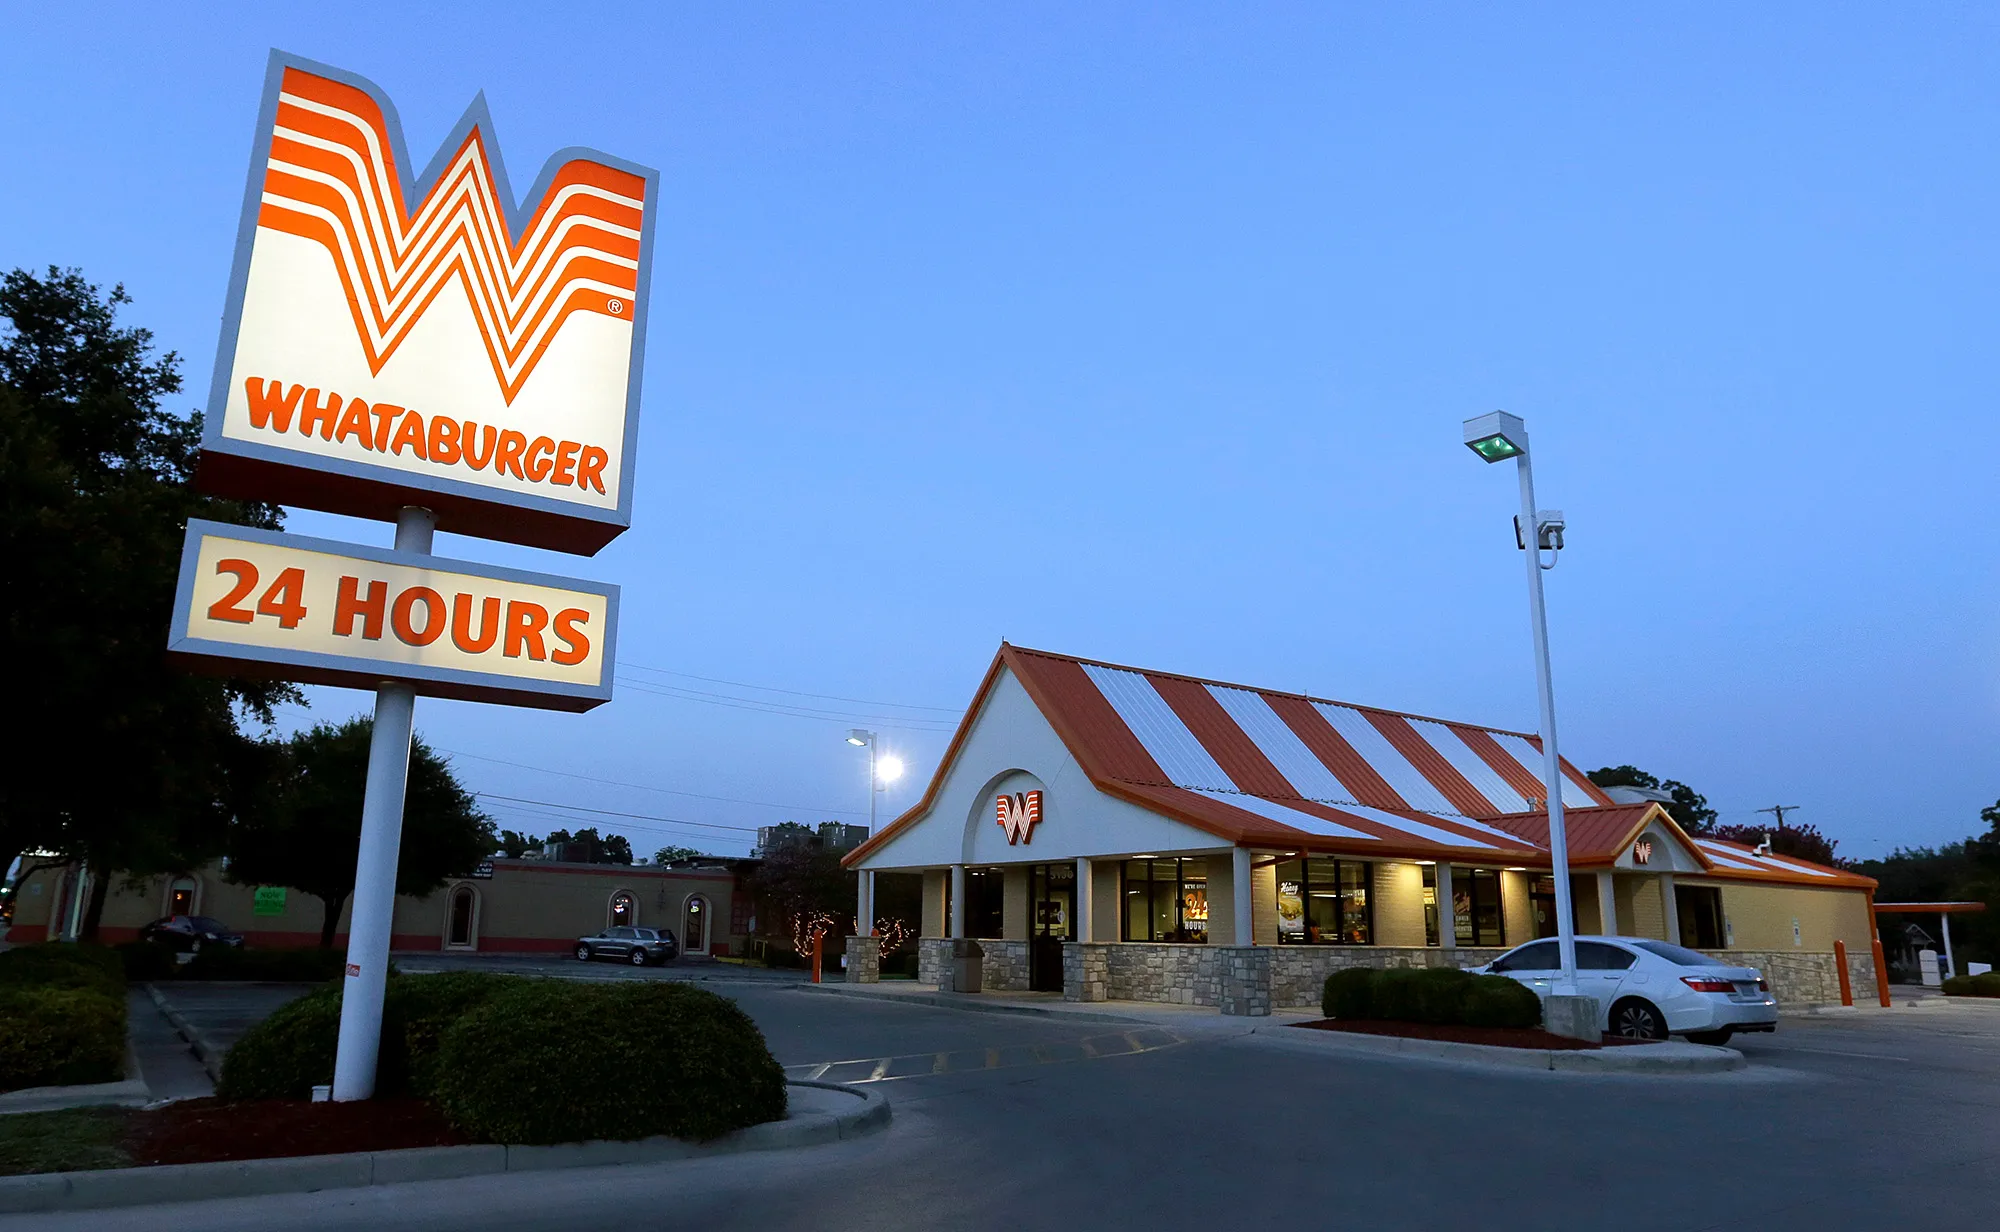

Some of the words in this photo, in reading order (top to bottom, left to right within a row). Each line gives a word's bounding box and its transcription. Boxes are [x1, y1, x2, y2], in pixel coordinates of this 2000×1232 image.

[245, 376, 609, 496] WHATABURGER
[207, 559, 308, 629] 24
[332, 576, 592, 665] HOURS
[1184, 920, 1207, 930] HOURS
